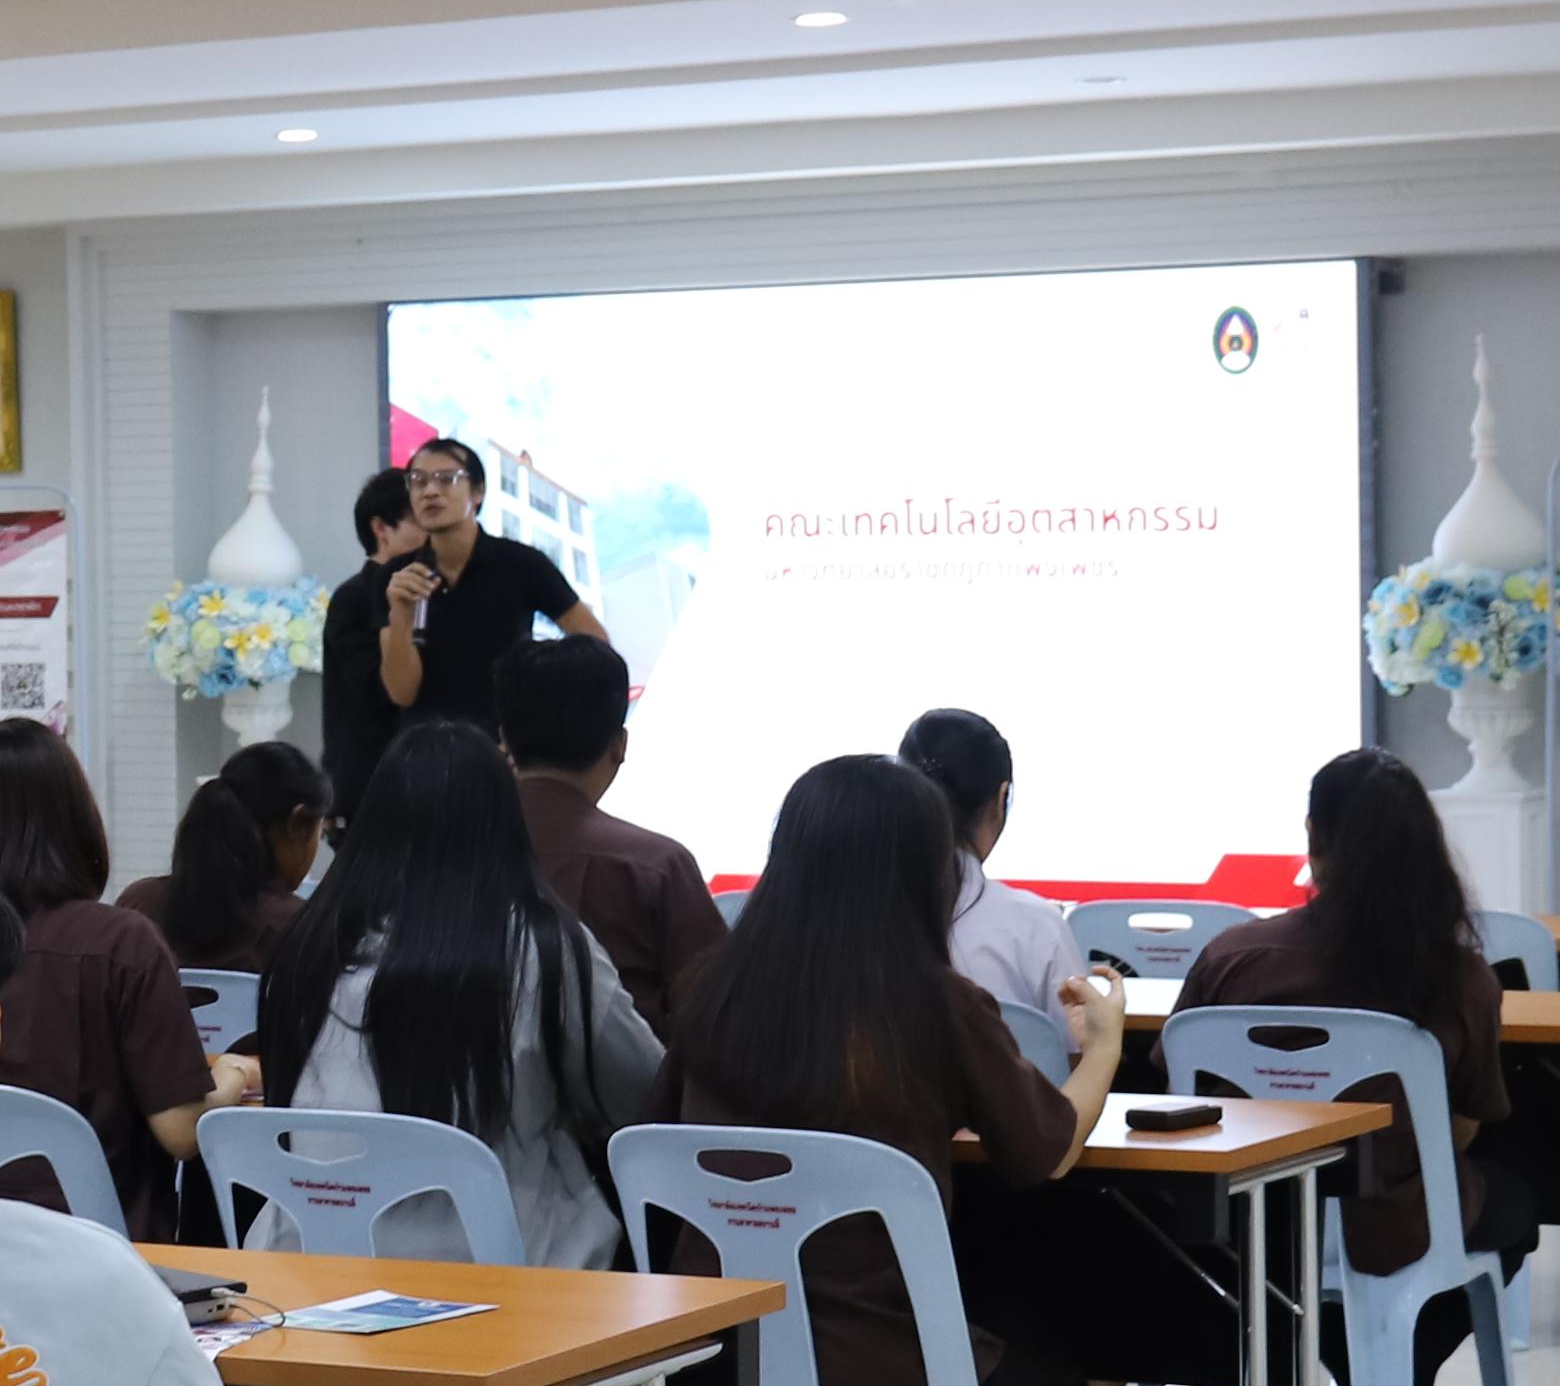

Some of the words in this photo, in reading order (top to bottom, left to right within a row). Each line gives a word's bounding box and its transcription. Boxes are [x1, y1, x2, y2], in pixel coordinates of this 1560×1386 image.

[765, 497, 1218, 546] คณะเทคโนโลยีอุตสาหกรรม
